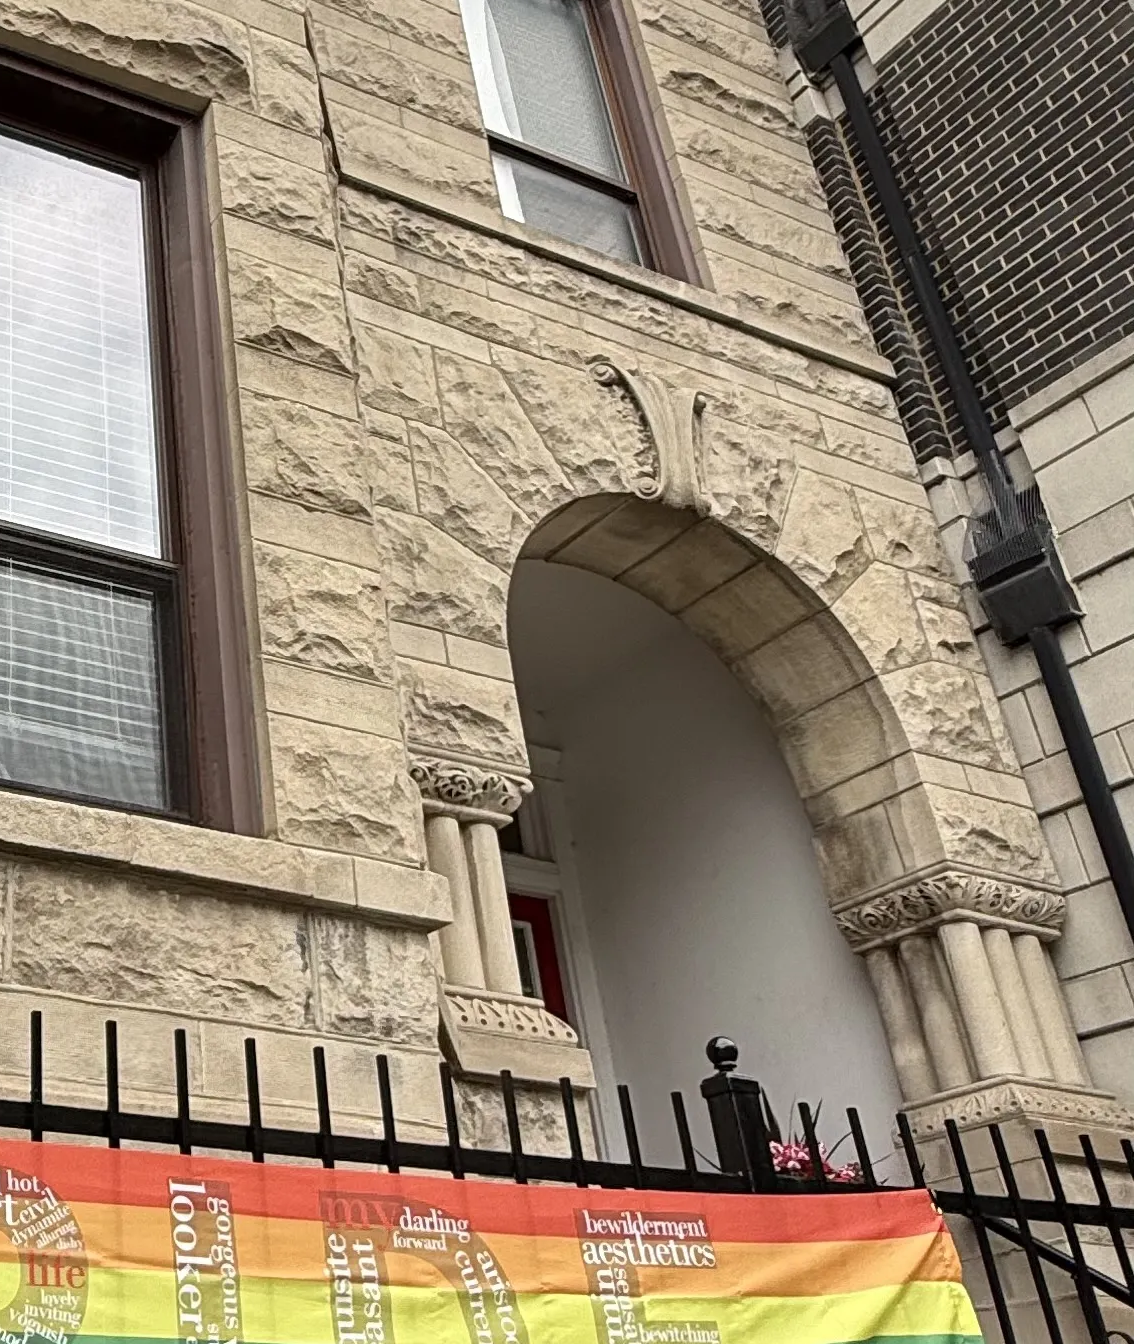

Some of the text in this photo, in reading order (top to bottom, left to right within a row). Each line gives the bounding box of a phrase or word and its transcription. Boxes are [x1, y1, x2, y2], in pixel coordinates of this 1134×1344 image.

[6, 1169, 41, 1193] hot
[19, 1187, 59, 1224] civil
[11, 1205, 72, 1248] dynamite
[36, 1219, 78, 1249] alluring
[399, 1206, 470, 1244] darling
[582, 1209, 707, 1237] bewilderment
[168, 1178, 214, 1334] looker
[392, 1231, 447, 1251] forward
[582, 1230, 716, 1267] aesthetics
[206, 1197, 239, 1330] gorgeous
[24, 1299, 82, 1330] inviting
[41, 1288, 80, 1311] lovely
